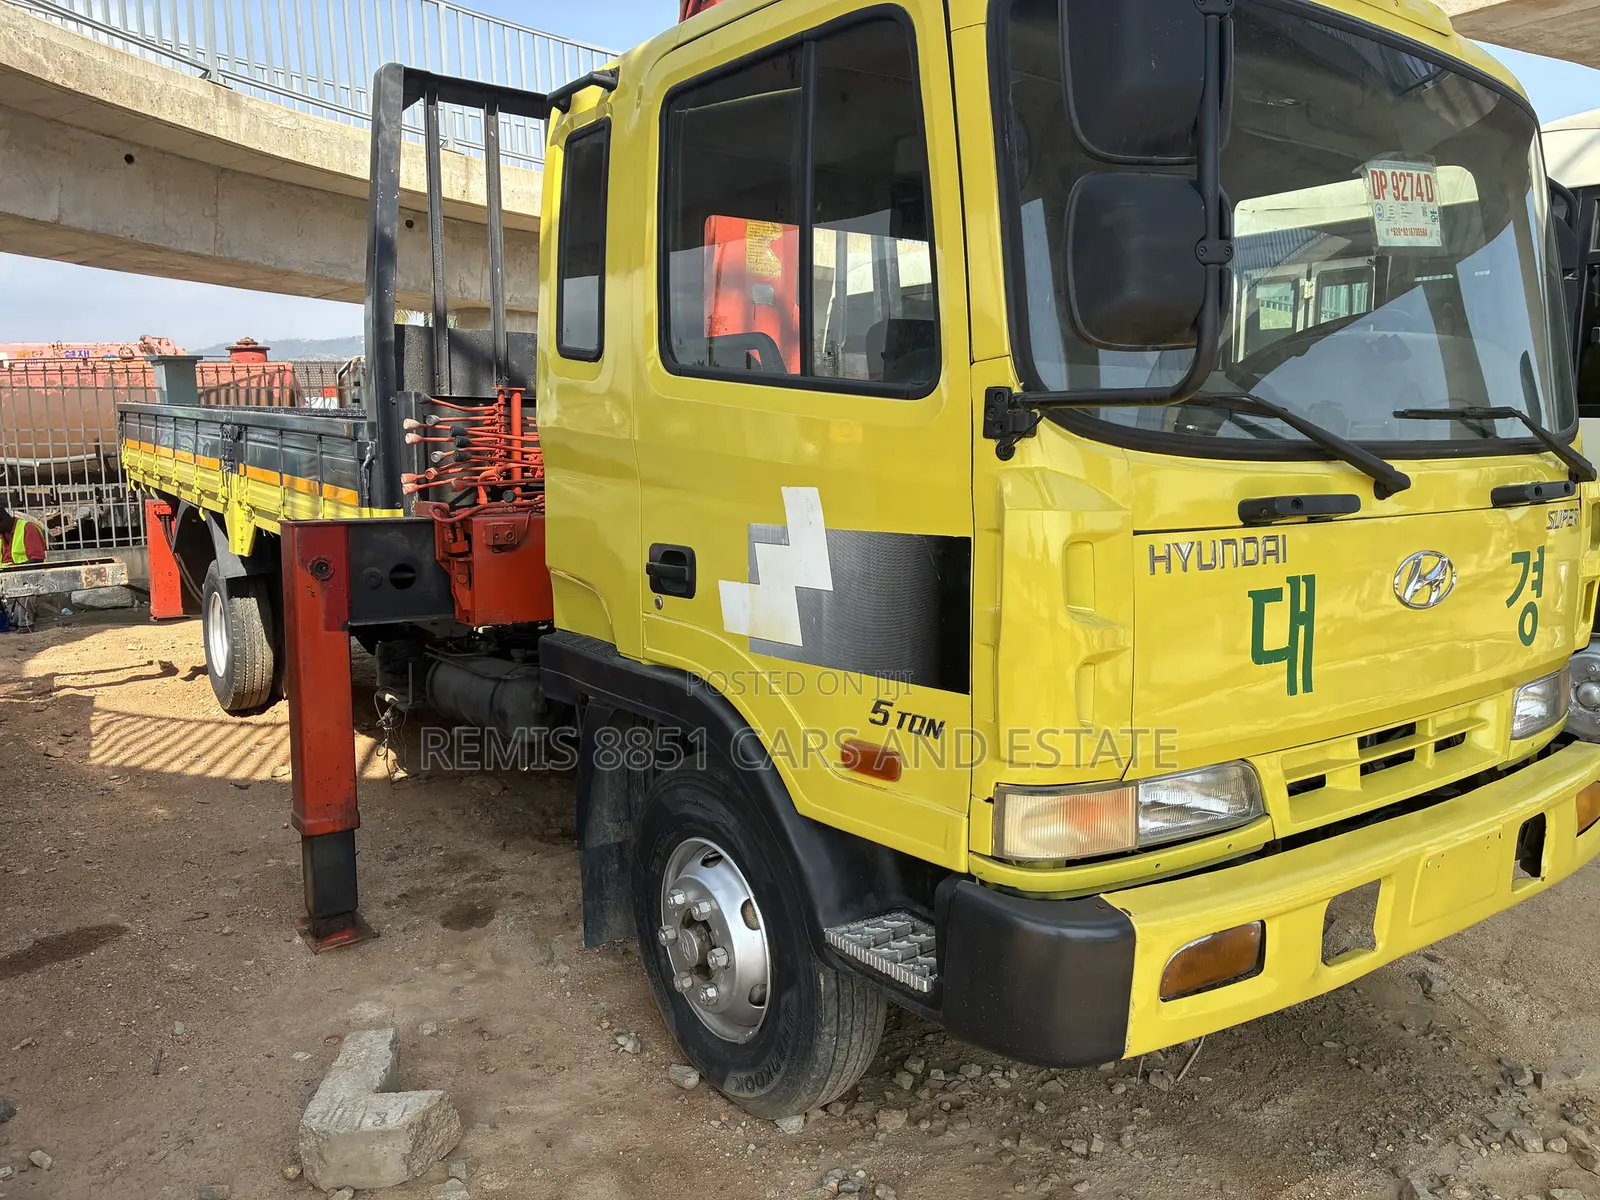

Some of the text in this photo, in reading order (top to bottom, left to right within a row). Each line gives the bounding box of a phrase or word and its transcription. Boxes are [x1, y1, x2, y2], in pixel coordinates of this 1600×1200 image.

[1370, 169, 1388, 200] DP
[1546, 508, 1579, 530] SUPER
[1149, 534, 1287, 575] HYUNDAI
[1248, 545, 1545, 697] 대 경
[868, 699, 946, 740] 5 TON
